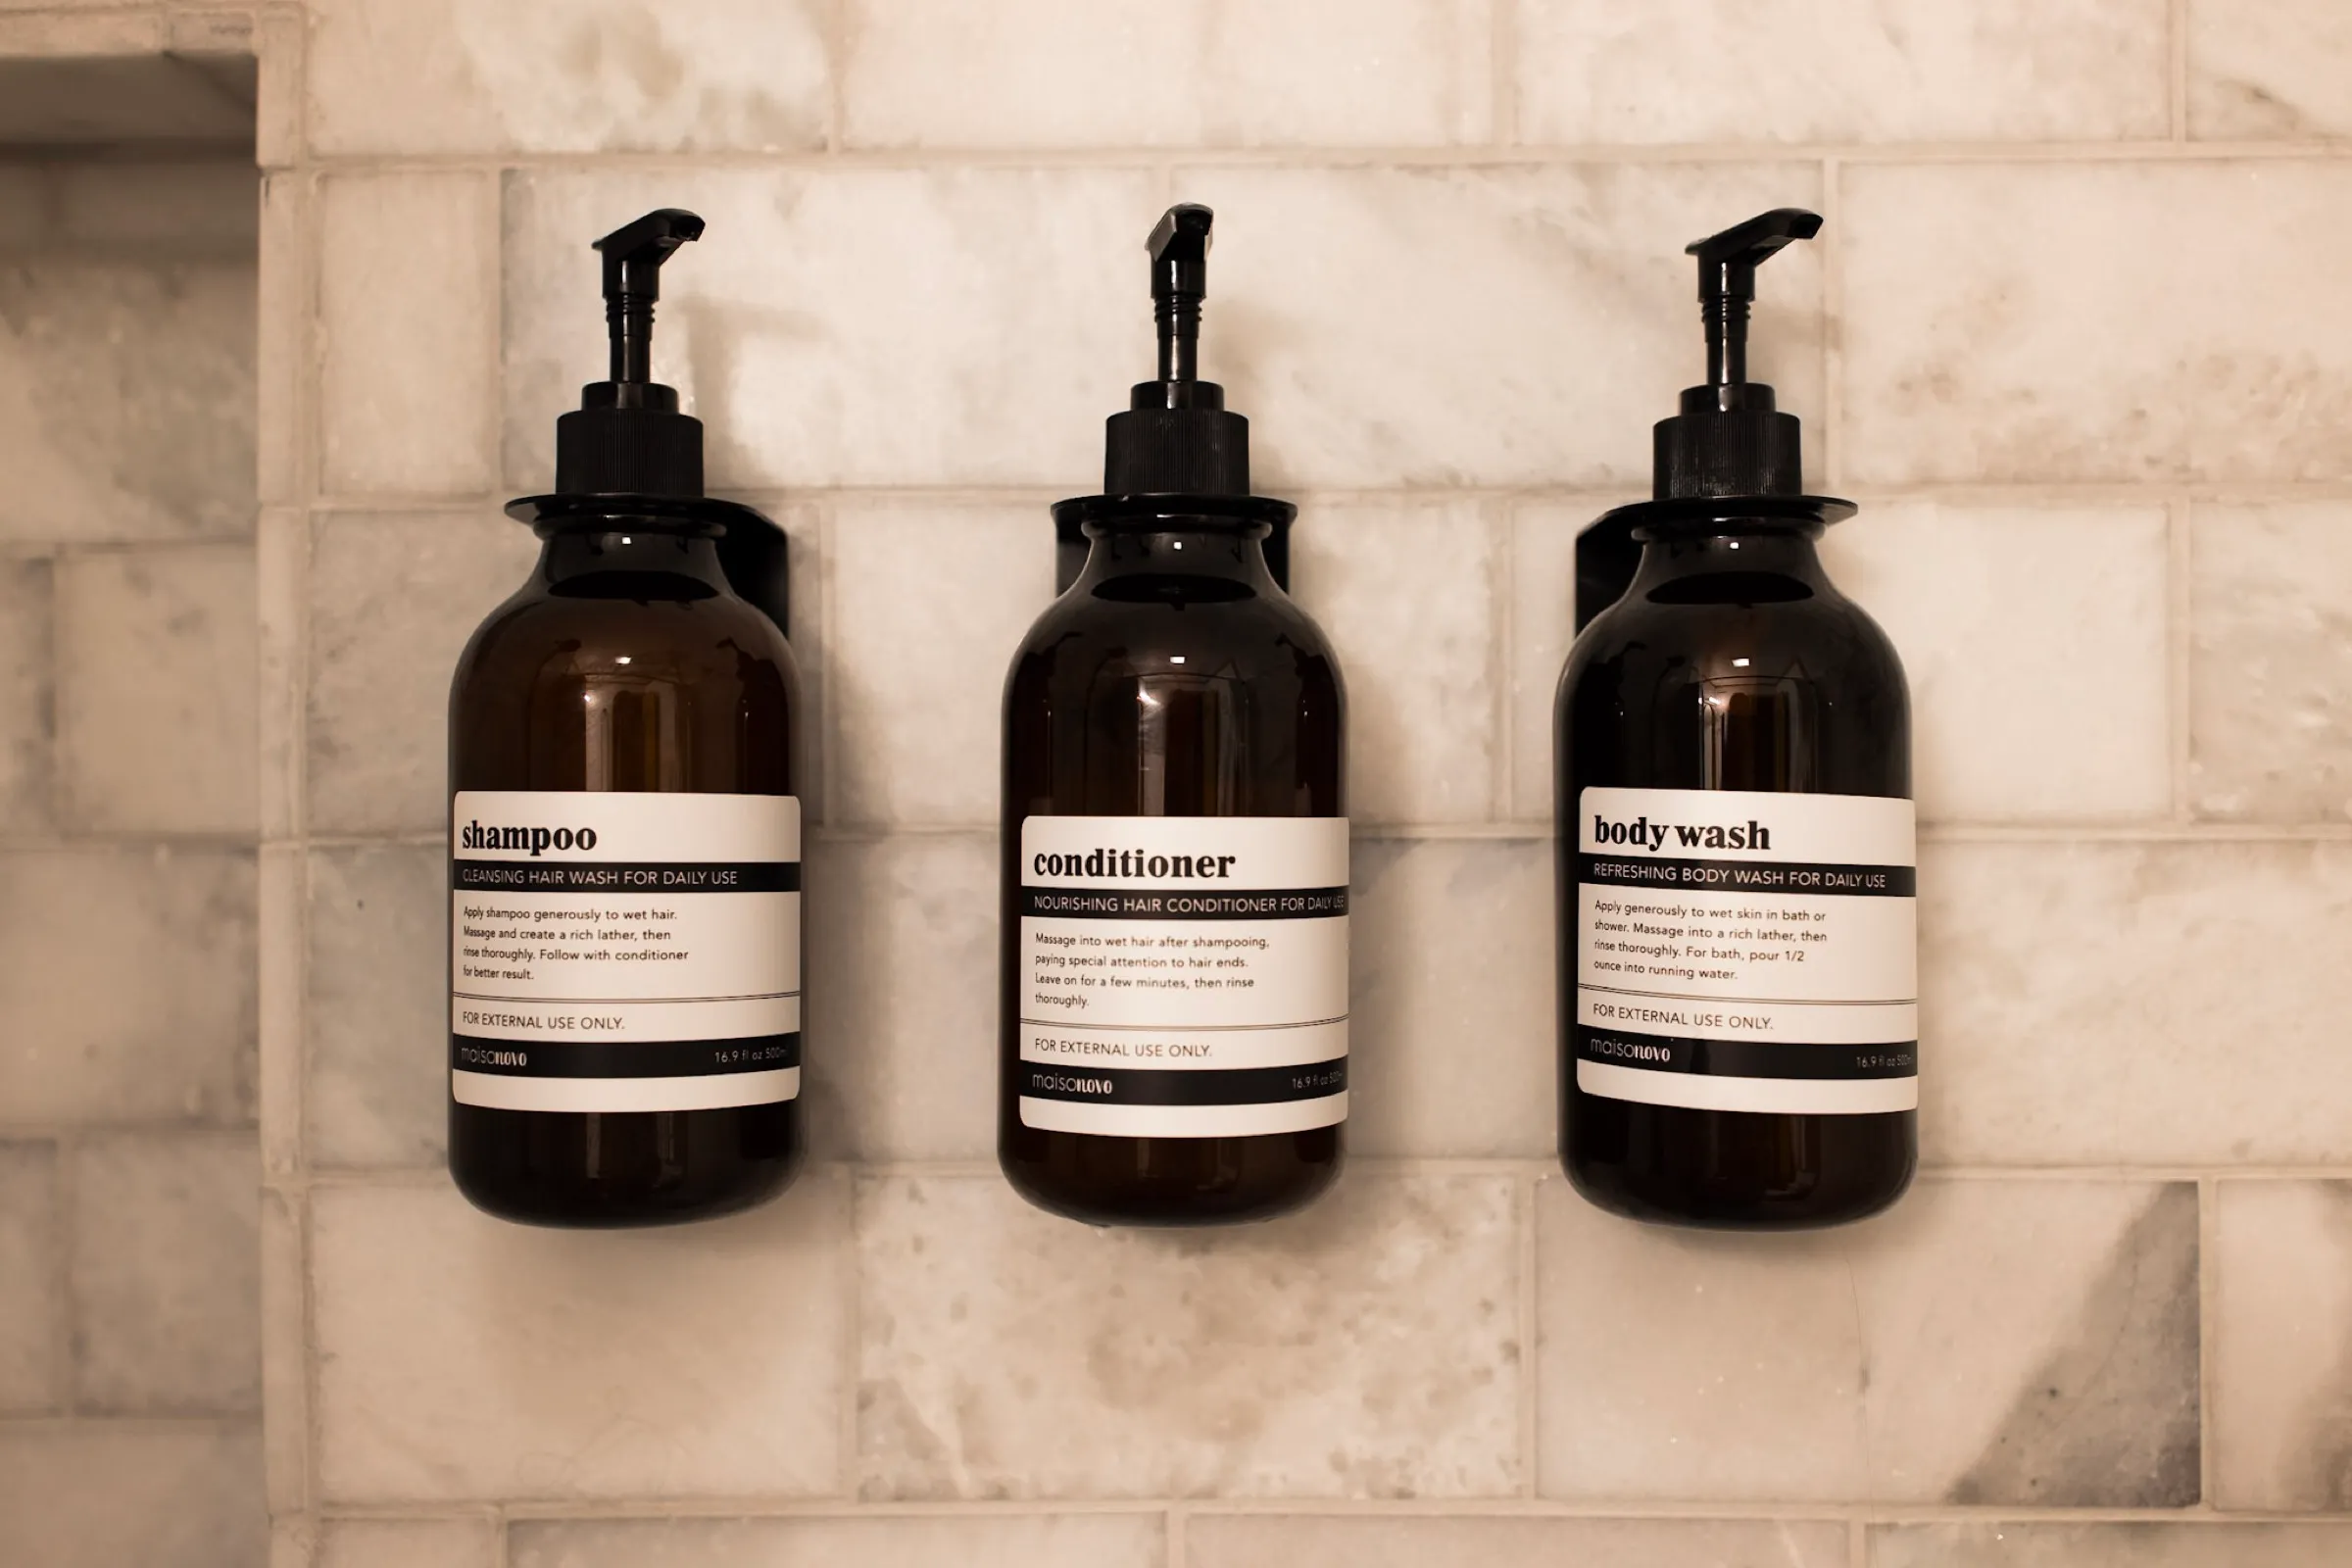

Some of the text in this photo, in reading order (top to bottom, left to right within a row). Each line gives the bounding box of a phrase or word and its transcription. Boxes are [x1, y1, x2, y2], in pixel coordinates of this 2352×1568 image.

[463, 820, 597, 856] shampoo
[1594, 815, 1771, 852] body wash
[1034, 849, 1236, 878] conditioner
[463, 868, 737, 885] CLEANSING HAIR WASH FOR DAILY USE
[1594, 863, 1886, 888] REFRESHING BODY WASH FOR DAILY USE
[1035, 896, 1118, 911] NOURISHING
[1124, 899, 1160, 911] HAIR
[1167, 899, 1276, 912] CONDITIONER
[1282, 898, 1303, 911] FOR
[1308, 896, 1332, 910] DAILY
[1595, 900, 1826, 921] Apply generously to wet skin in bath or
[464, 907, 676, 921] Apply shampoo generously to wet hair.
[464, 926, 495, 940] Massage
[499, 928, 516, 939] and
[520, 930, 555, 940] create
[570, 929, 593, 940] rich
[599, 930, 637, 942] lather,
[643, 930, 670, 940] then
[1595, 920, 1630, 932] shower.
[1634, 923, 1684, 938] Massage
[1689, 927, 1712, 938] into
[1729, 929, 1752, 940] rich
[1757, 930, 1795, 942] lather,
[1801, 931, 1827, 942] then
[1036, 933, 1075, 947] Massage
[1080, 936, 1101, 946] into
[1105, 938, 1126, 947] wet
[1131, 937, 1153, 947] hair
[1158, 937, 1187, 948] after
[464, 948, 688, 961] rinse thoroughly. Follow with conditioner
[1594, 941, 1804, 962] rinse thoroughly. For bath, pour 1/2
[1036, 955, 1249, 968] paying special attention to hair ends.
[464, 966, 533, 980] for better result.
[1594, 963, 1738, 980] ounce into running water.
[1036, 974, 1060, 984] Leave
[1081, 975, 1096, 987] for
[1110, 977, 1132, 987] few
[1137, 978, 1189, 990] minutes,
[1195, 978, 1222, 988] then
[1227, 978, 1253, 988] rinse
[1036, 994, 1089, 1007] thoroughly.
[464, 1012, 625, 1030] FOR EXTERNAL USE ONLY.
[1593, 1004, 1773, 1029] FOR EXTERNAL USE ONLY.
[1036, 1039, 1212, 1056] FOR EXTERNAL USE ONLY.
[1591, 1039, 1670, 1061] maisonovo
[462, 1047, 527, 1066] maisonovo
[714, 1051, 738, 1062] 16.9
[1856, 1056, 1877, 1068] 16.9
[1033, 1074, 1112, 1095] maisonovo
[1292, 1077, 1310, 1089] 16.9
